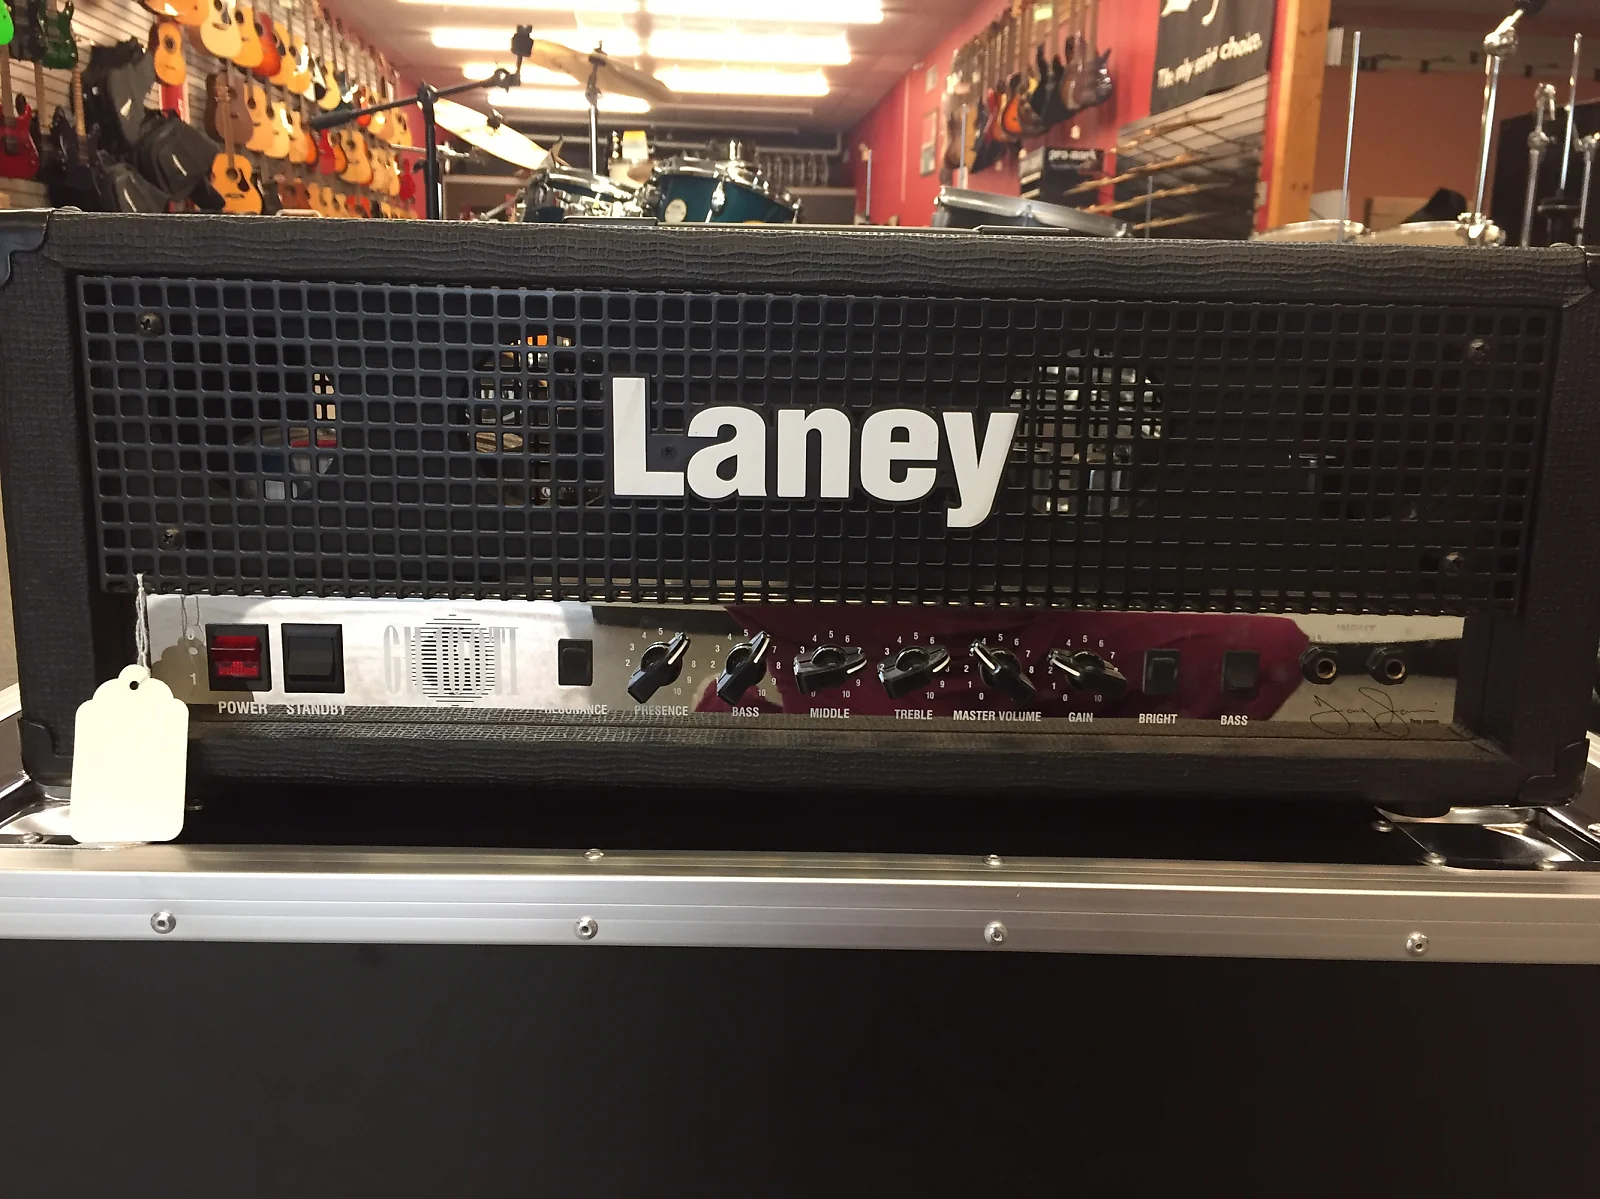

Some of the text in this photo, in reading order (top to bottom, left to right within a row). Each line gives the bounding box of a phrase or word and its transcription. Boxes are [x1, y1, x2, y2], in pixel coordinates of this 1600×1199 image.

[612, 377, 1018, 528] Laney
[896, 636, 902, 644] 4
[929, 636, 935, 645] 6
[981, 637, 987, 646] 4
[998, 633, 1004, 642] 5
[1014, 638, 1020, 646] 6
[1082, 634, 1088, 643] 5
[1066, 638, 1071, 647] 4
[1098, 639, 1104, 647] 6
[625, 659, 630, 667] 2
[629, 643, 635, 651] 3
[691, 660, 696, 668] 8
[884, 648, 890, 656] 3
[1025, 649, 1031, 658] 7
[1110, 651, 1116, 660] 7
[800, 646, 806, 654] 3
[828, 630, 834, 639] 5
[845, 635, 850, 643] 6
[856, 679, 861, 687] 9
[715, 644, 720, 652] 3
[758, 689, 766, 697] 10
[963, 664, 970, 673] 2
[1028, 665, 1035, 674] 8
[1048, 666, 1053, 674] 2
[190, 672, 196, 685] 1
[940, 680, 945, 688] 9
[968, 680, 972, 688] 1
[926, 691, 935, 699] 10
[979, 692, 984, 700] 0
[1062, 693, 1068, 702] 0
[1094, 694, 1103, 702] 10
[218, 701, 268, 714] POWER
[286, 704, 346, 716] STANDBY
[634, 705, 688, 716] PRESENCE
[732, 706, 760, 717] BASS
[810, 708, 850, 718] MIDDLE
[895, 709, 933, 720] TREBLE
[953, 710, 1042, 722] MASTER VOLUME
[1068, 712, 1094, 723] GAIN
[1138, 713, 1178, 724] BRIGHT
[1220, 715, 1248, 726] BASS
